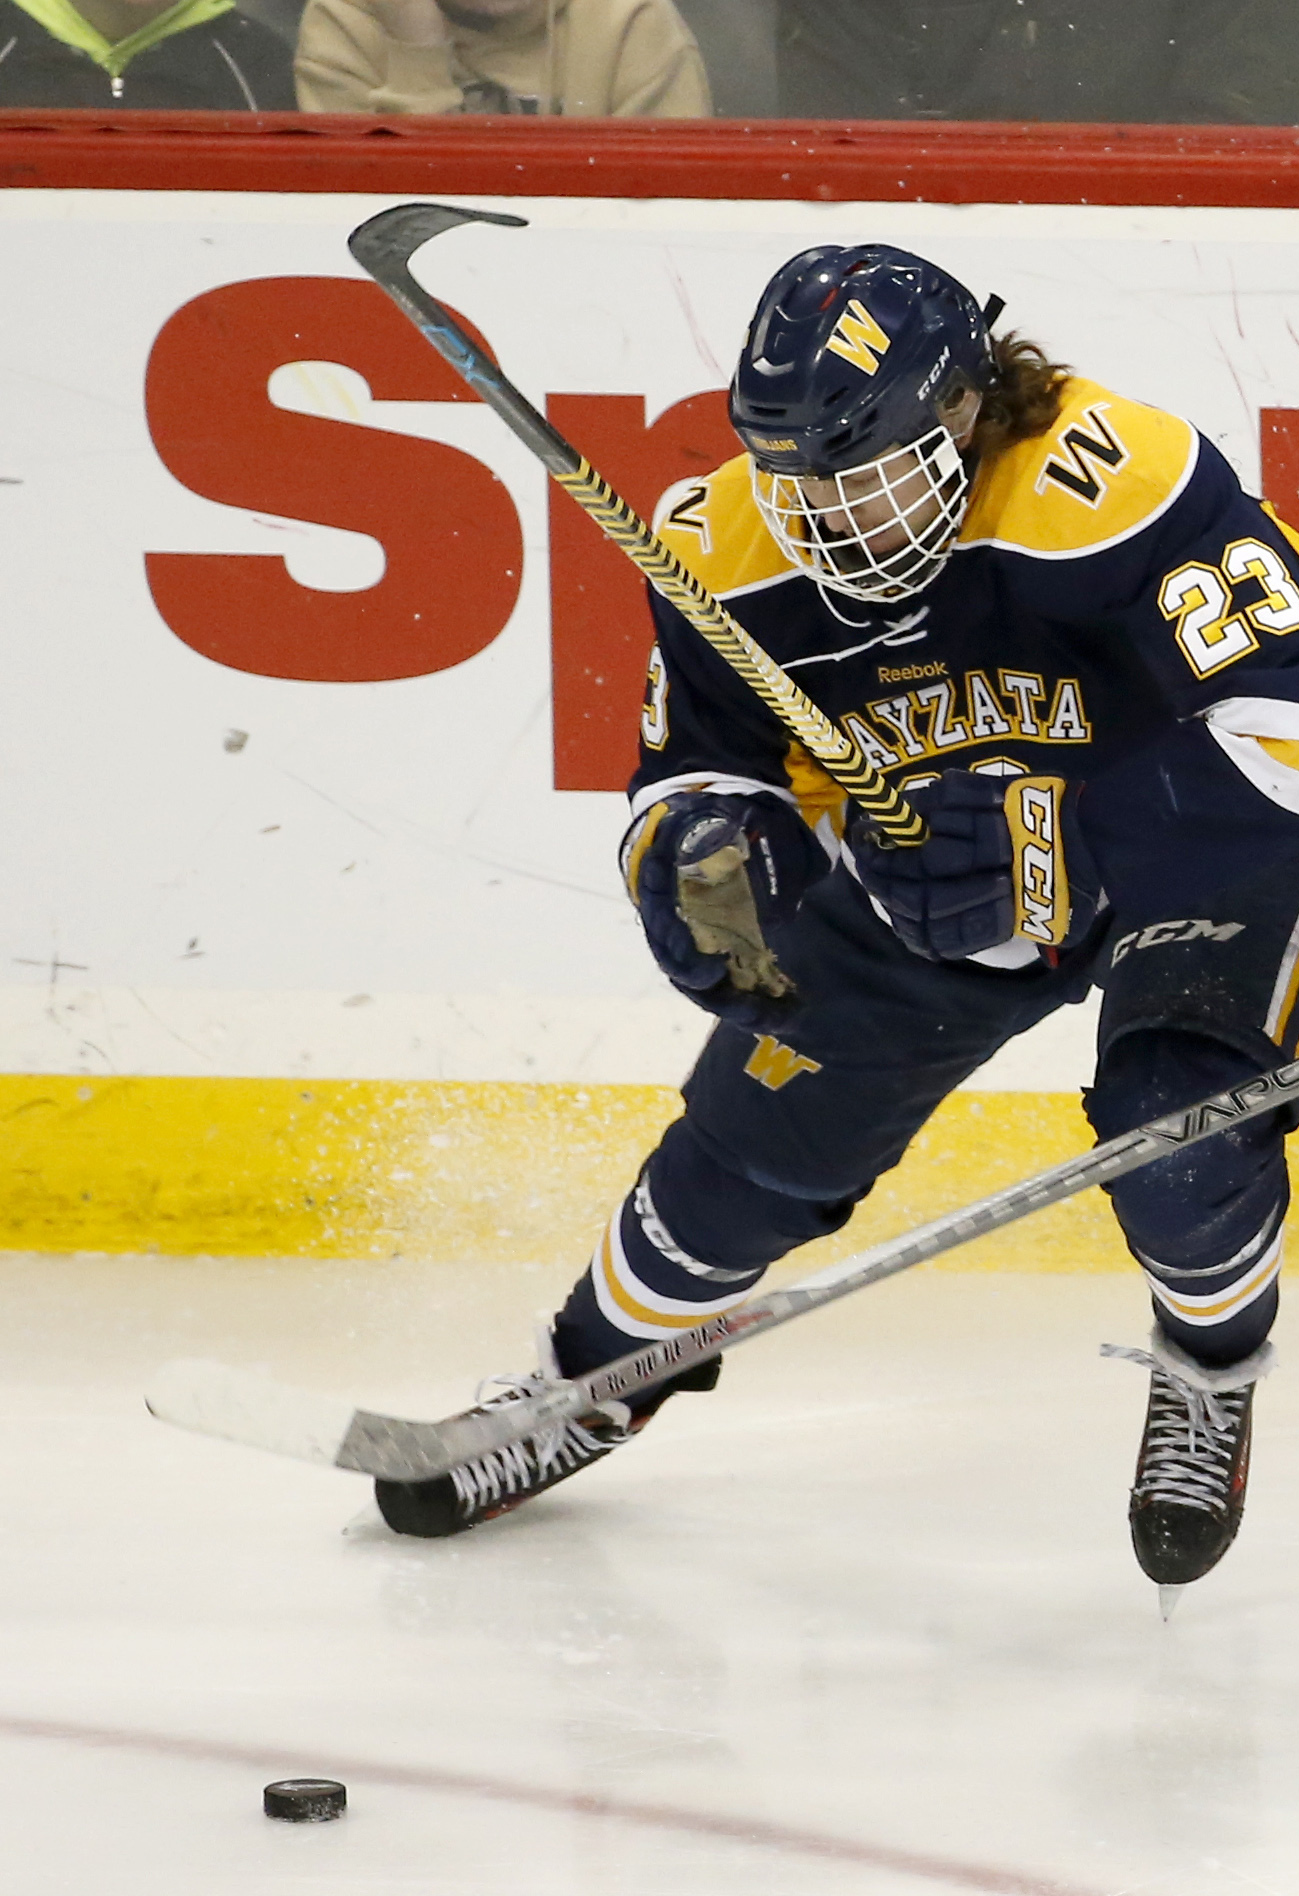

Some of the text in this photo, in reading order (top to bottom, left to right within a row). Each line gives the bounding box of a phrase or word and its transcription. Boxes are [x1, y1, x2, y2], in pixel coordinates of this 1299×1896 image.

[826, 297, 892, 377] W
[916, 345, 952, 401] CCM
[1034, 401, 1132, 511] W
[877, 661, 949, 684] Reebok
[839, 667, 1092, 776] AYZATA
[1021, 785, 1055, 943] CCM
[1110, 919, 1247, 969] CCM
[743, 1032, 824, 1091] W
